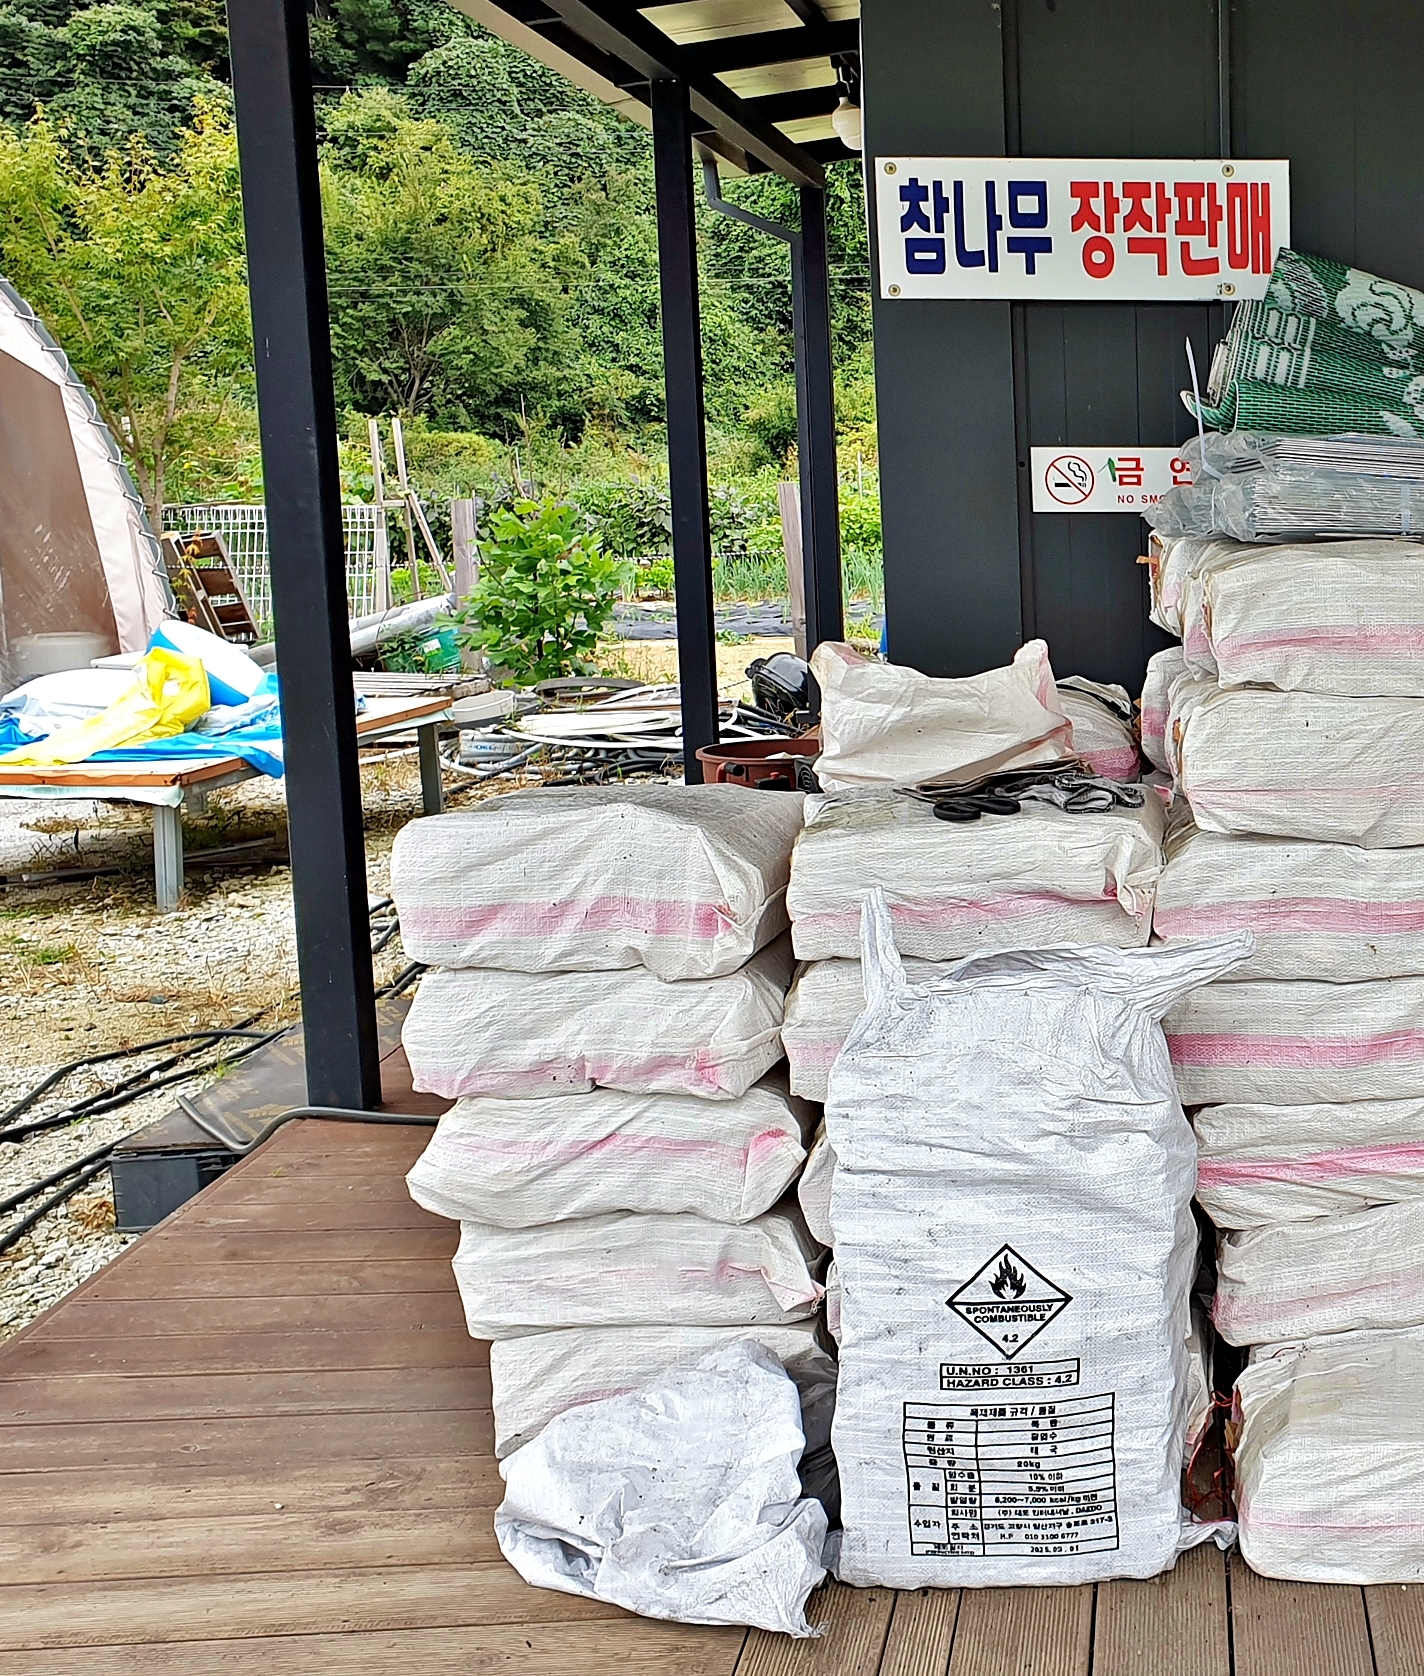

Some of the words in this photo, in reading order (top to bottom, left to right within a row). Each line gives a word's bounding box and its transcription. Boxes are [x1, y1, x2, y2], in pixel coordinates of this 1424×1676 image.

[898, 177, 1053, 276] 참나무
[1069, 180, 1273, 279] 장작판매
[1117, 494, 1134, 503] NO
[965, 1303, 1053, 1315] SPONTANEOUSLY
[973, 1313, 1046, 1324] COMBUSTIBLE
[1001, 1333, 1019, 1343] 4.2
[1006, 1365, 1034, 1374] 1361
[946, 1378, 999, 1388] HAZARD
[1002, 1376, 1043, 1386] CLASS
[1054, 1374, 1073, 1384] 4.2
[1016, 1460, 1041, 1468] 20kg
